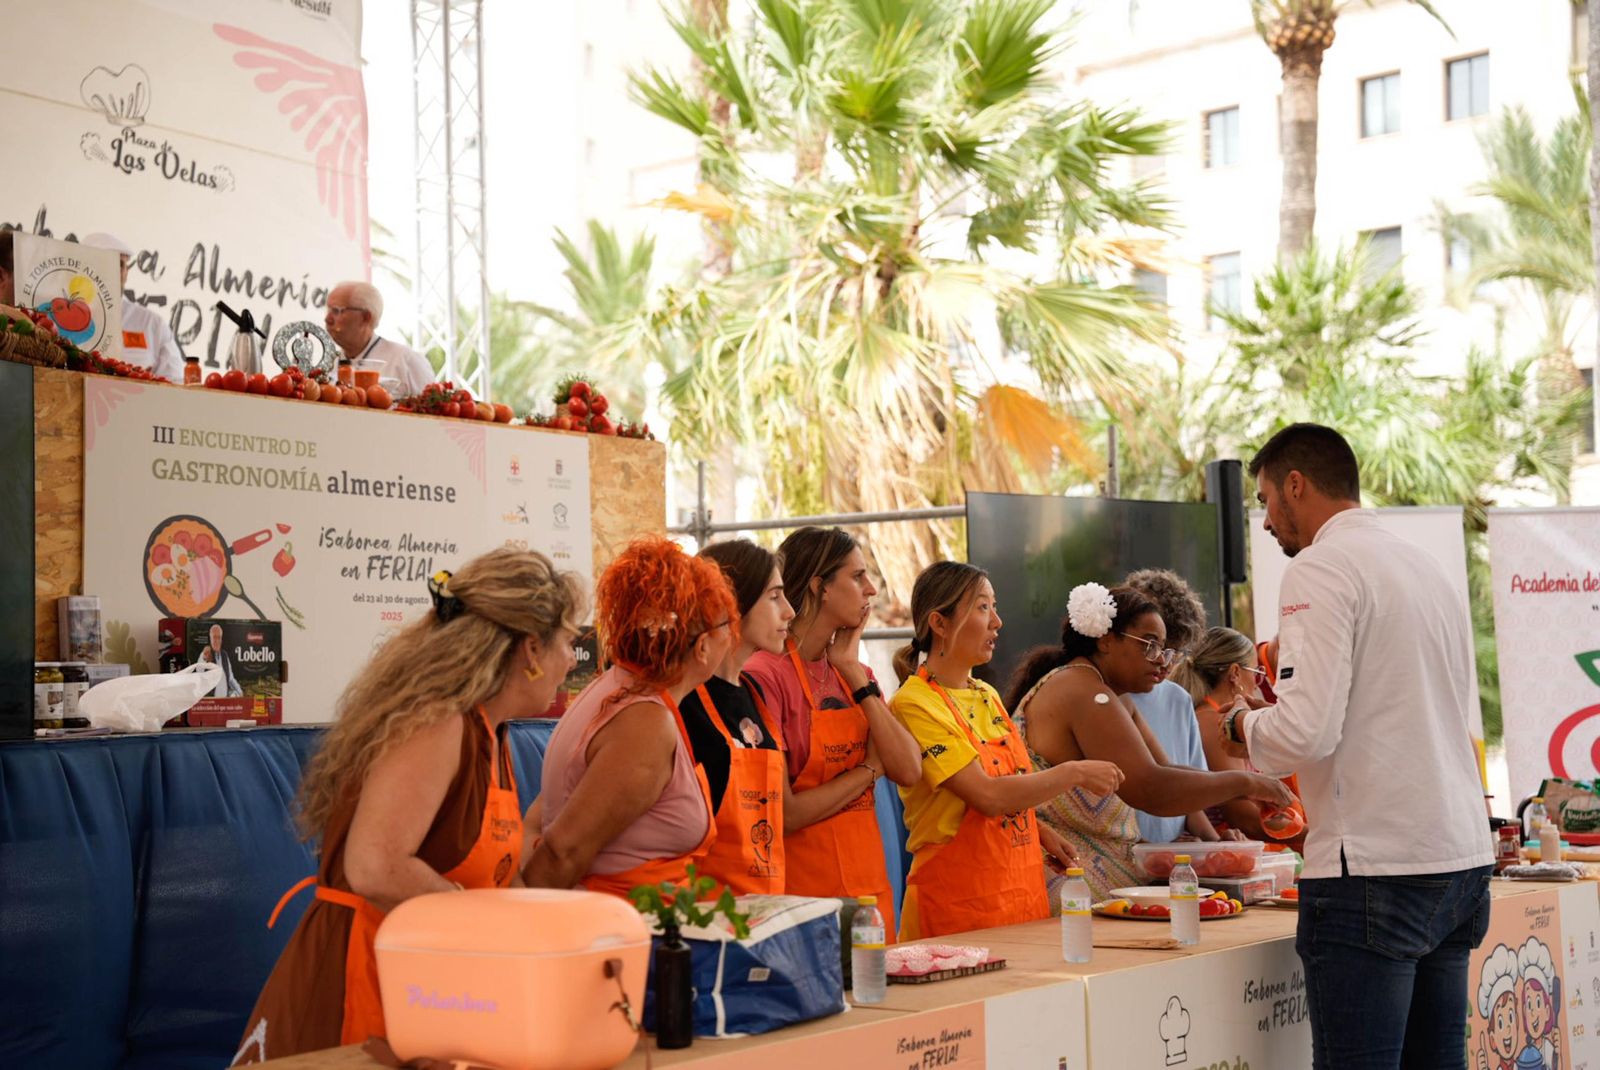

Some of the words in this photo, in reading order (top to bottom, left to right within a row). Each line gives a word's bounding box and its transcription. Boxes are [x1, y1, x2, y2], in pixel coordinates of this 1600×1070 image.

[121, 126, 156, 149] Plaza
[161, 140, 172, 151] de
[111, 138, 146, 174] Las
[23, 282, 34, 296] EL
[29, 256, 65, 281] TOMATE
[67, 258, 81, 268] DE
[152, 425, 175, 444] III
[179, 428, 291, 456] ENCUENTRO
[295, 440, 317, 458] DE
[152, 458, 323, 492] GASTRONOMÍA
[327, 470, 456, 503] almeriense
[340, 565, 360, 580] en
[367, 555, 433, 582] FERIA!
[1511, 572, 1580, 593] Academia
[1583, 571, 1600, 592] de
[353, 592, 365, 603] del
[366, 595, 375, 604] 23
[376, 594, 383, 603] al
[384, 596, 393, 605] 30
[394, 595, 403, 604] de
[404, 596, 429, 606] agosto
[380, 611, 403, 622] 2025
[235, 646, 275, 662] Lobello
[1258, 1016, 1270, 1032] en
[1272, 994, 1310, 1028] FERIA
